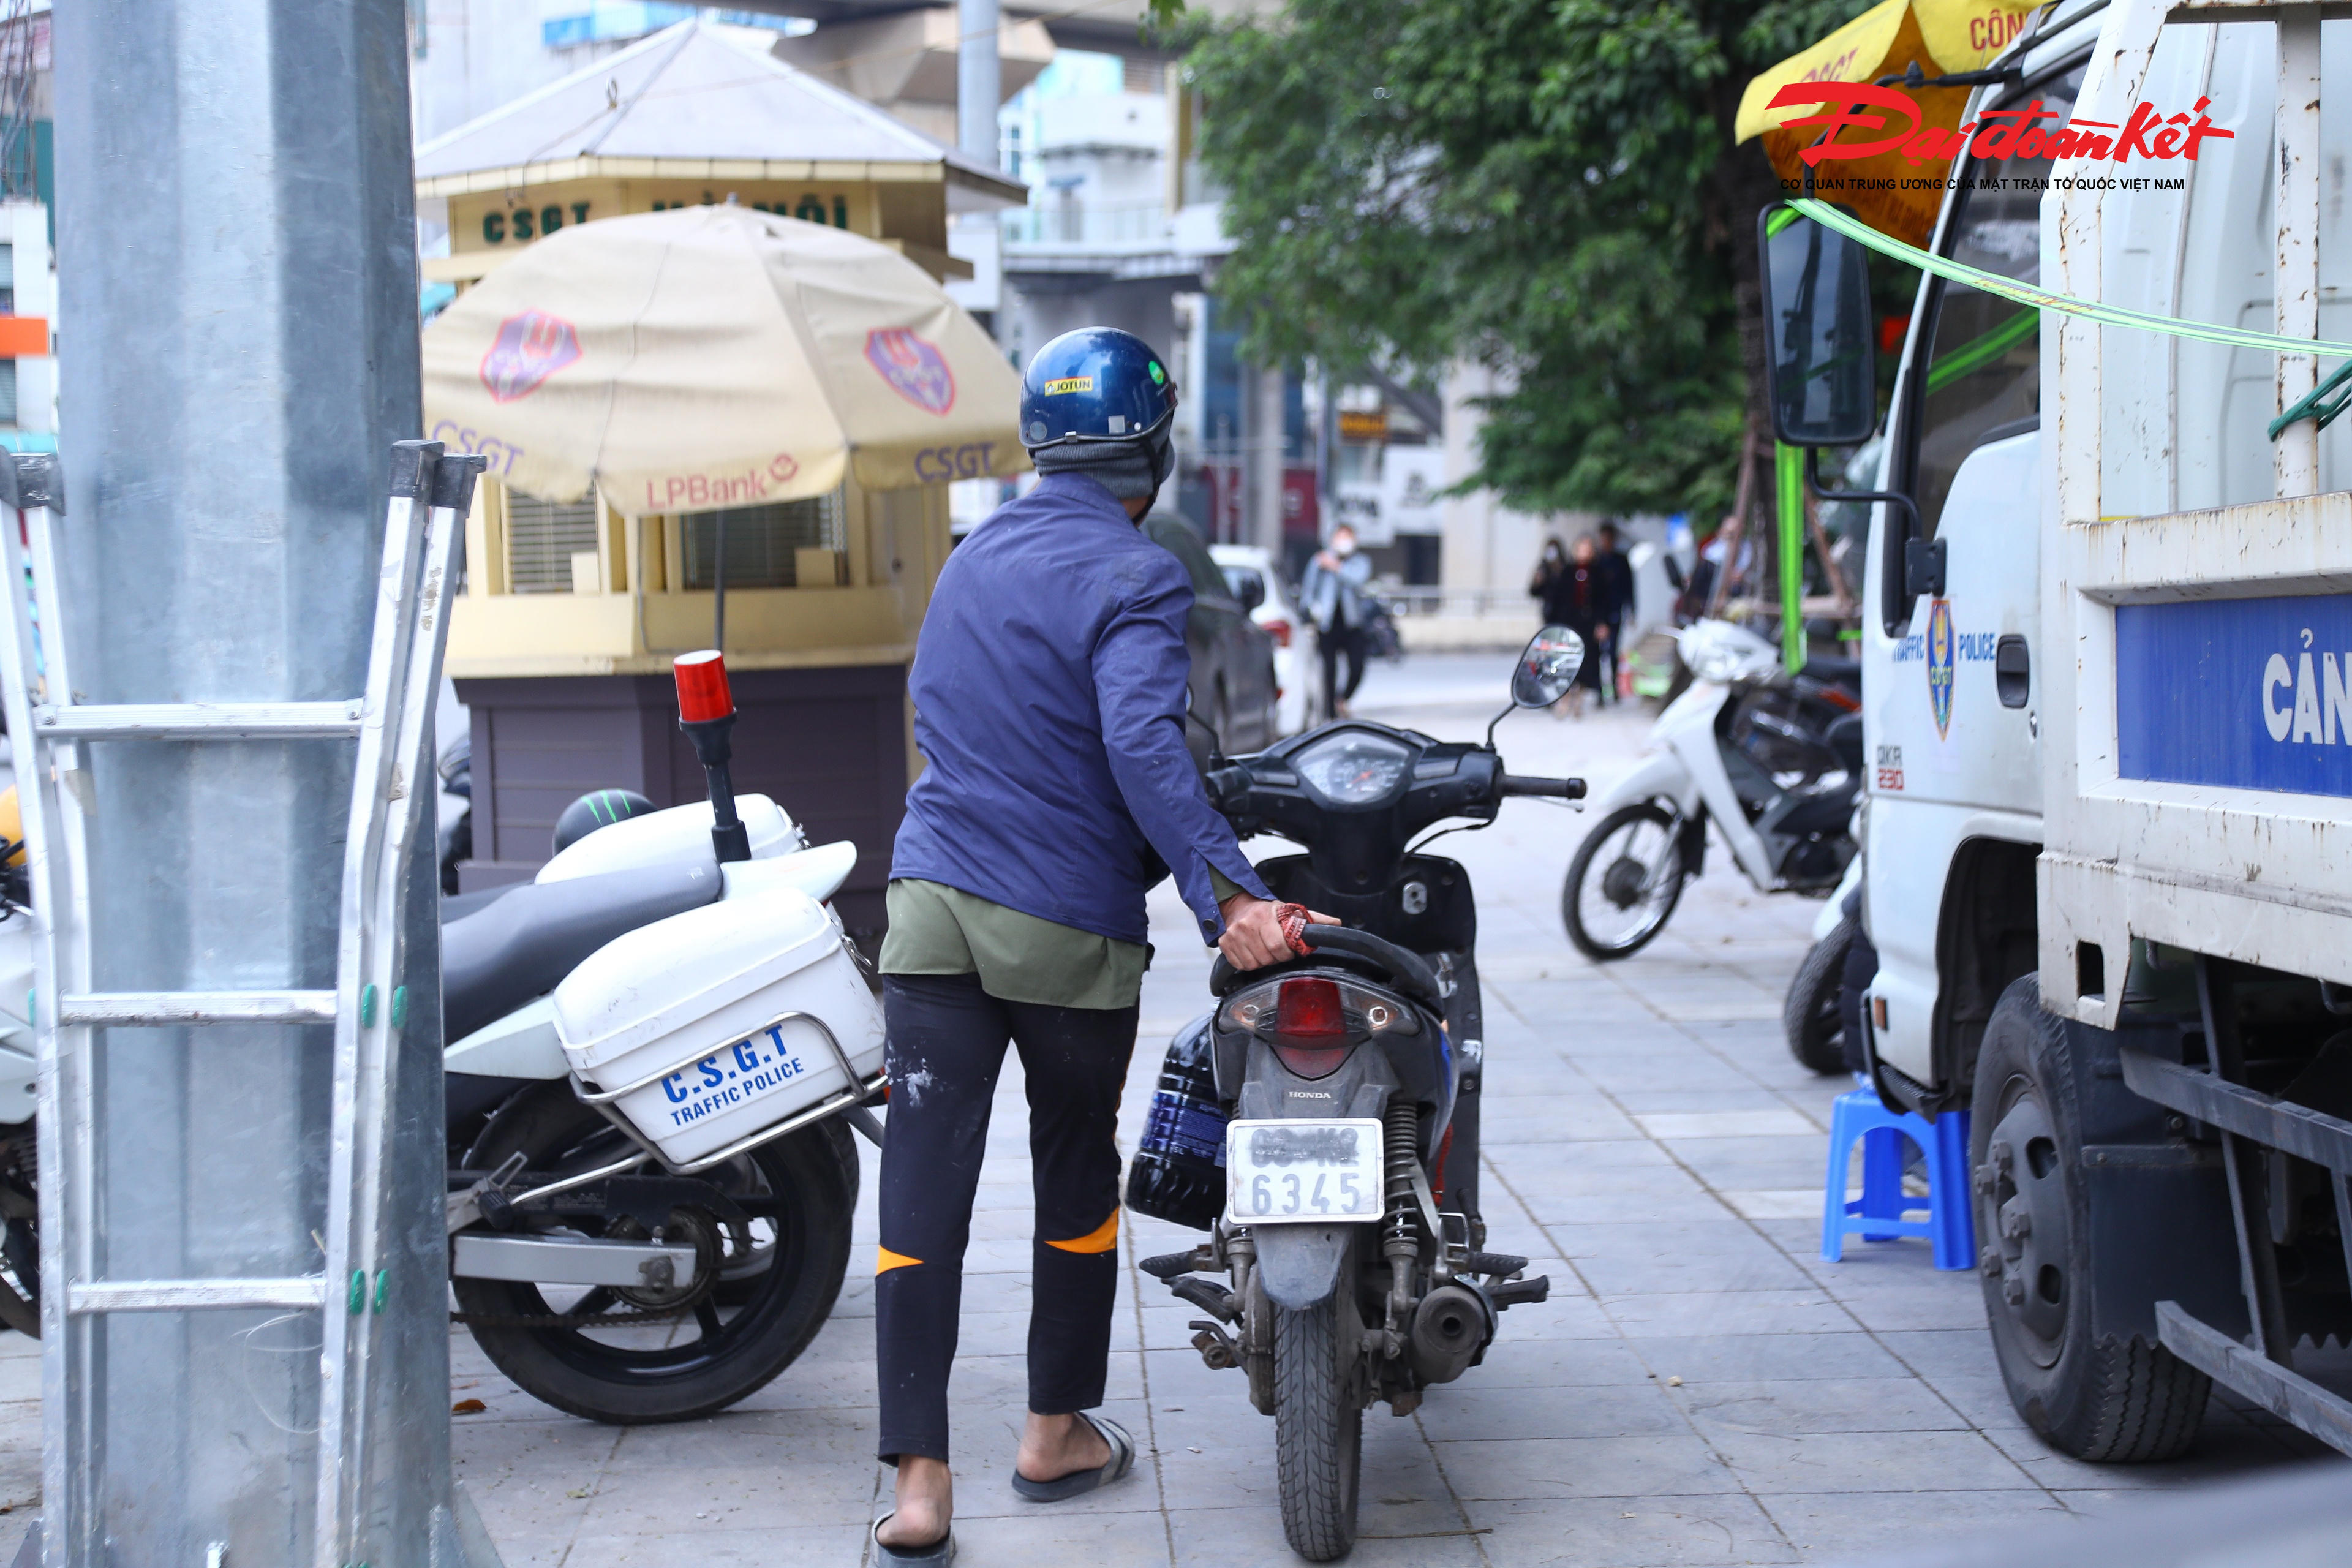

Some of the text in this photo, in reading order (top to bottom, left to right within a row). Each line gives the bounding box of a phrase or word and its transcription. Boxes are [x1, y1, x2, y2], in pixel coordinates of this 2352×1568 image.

[1970, 9, 2028, 50] CÔN
[483, 200, 590, 244] CSGT
[1056, 380, 1090, 392] JOTUN
[914, 442, 995, 482] CSGT
[646, 469, 767, 509] LPBank
[1959, 632, 1996, 661] POLICE
[2262, 627, 2352, 747] CẢN
[1878, 768, 1904, 791] 230
[661, 1024, 788, 1103] C.S.G.T
[671, 1058, 804, 1126] TRAFFIC POLICE
[1252, 1173, 1360, 1215] 6345
